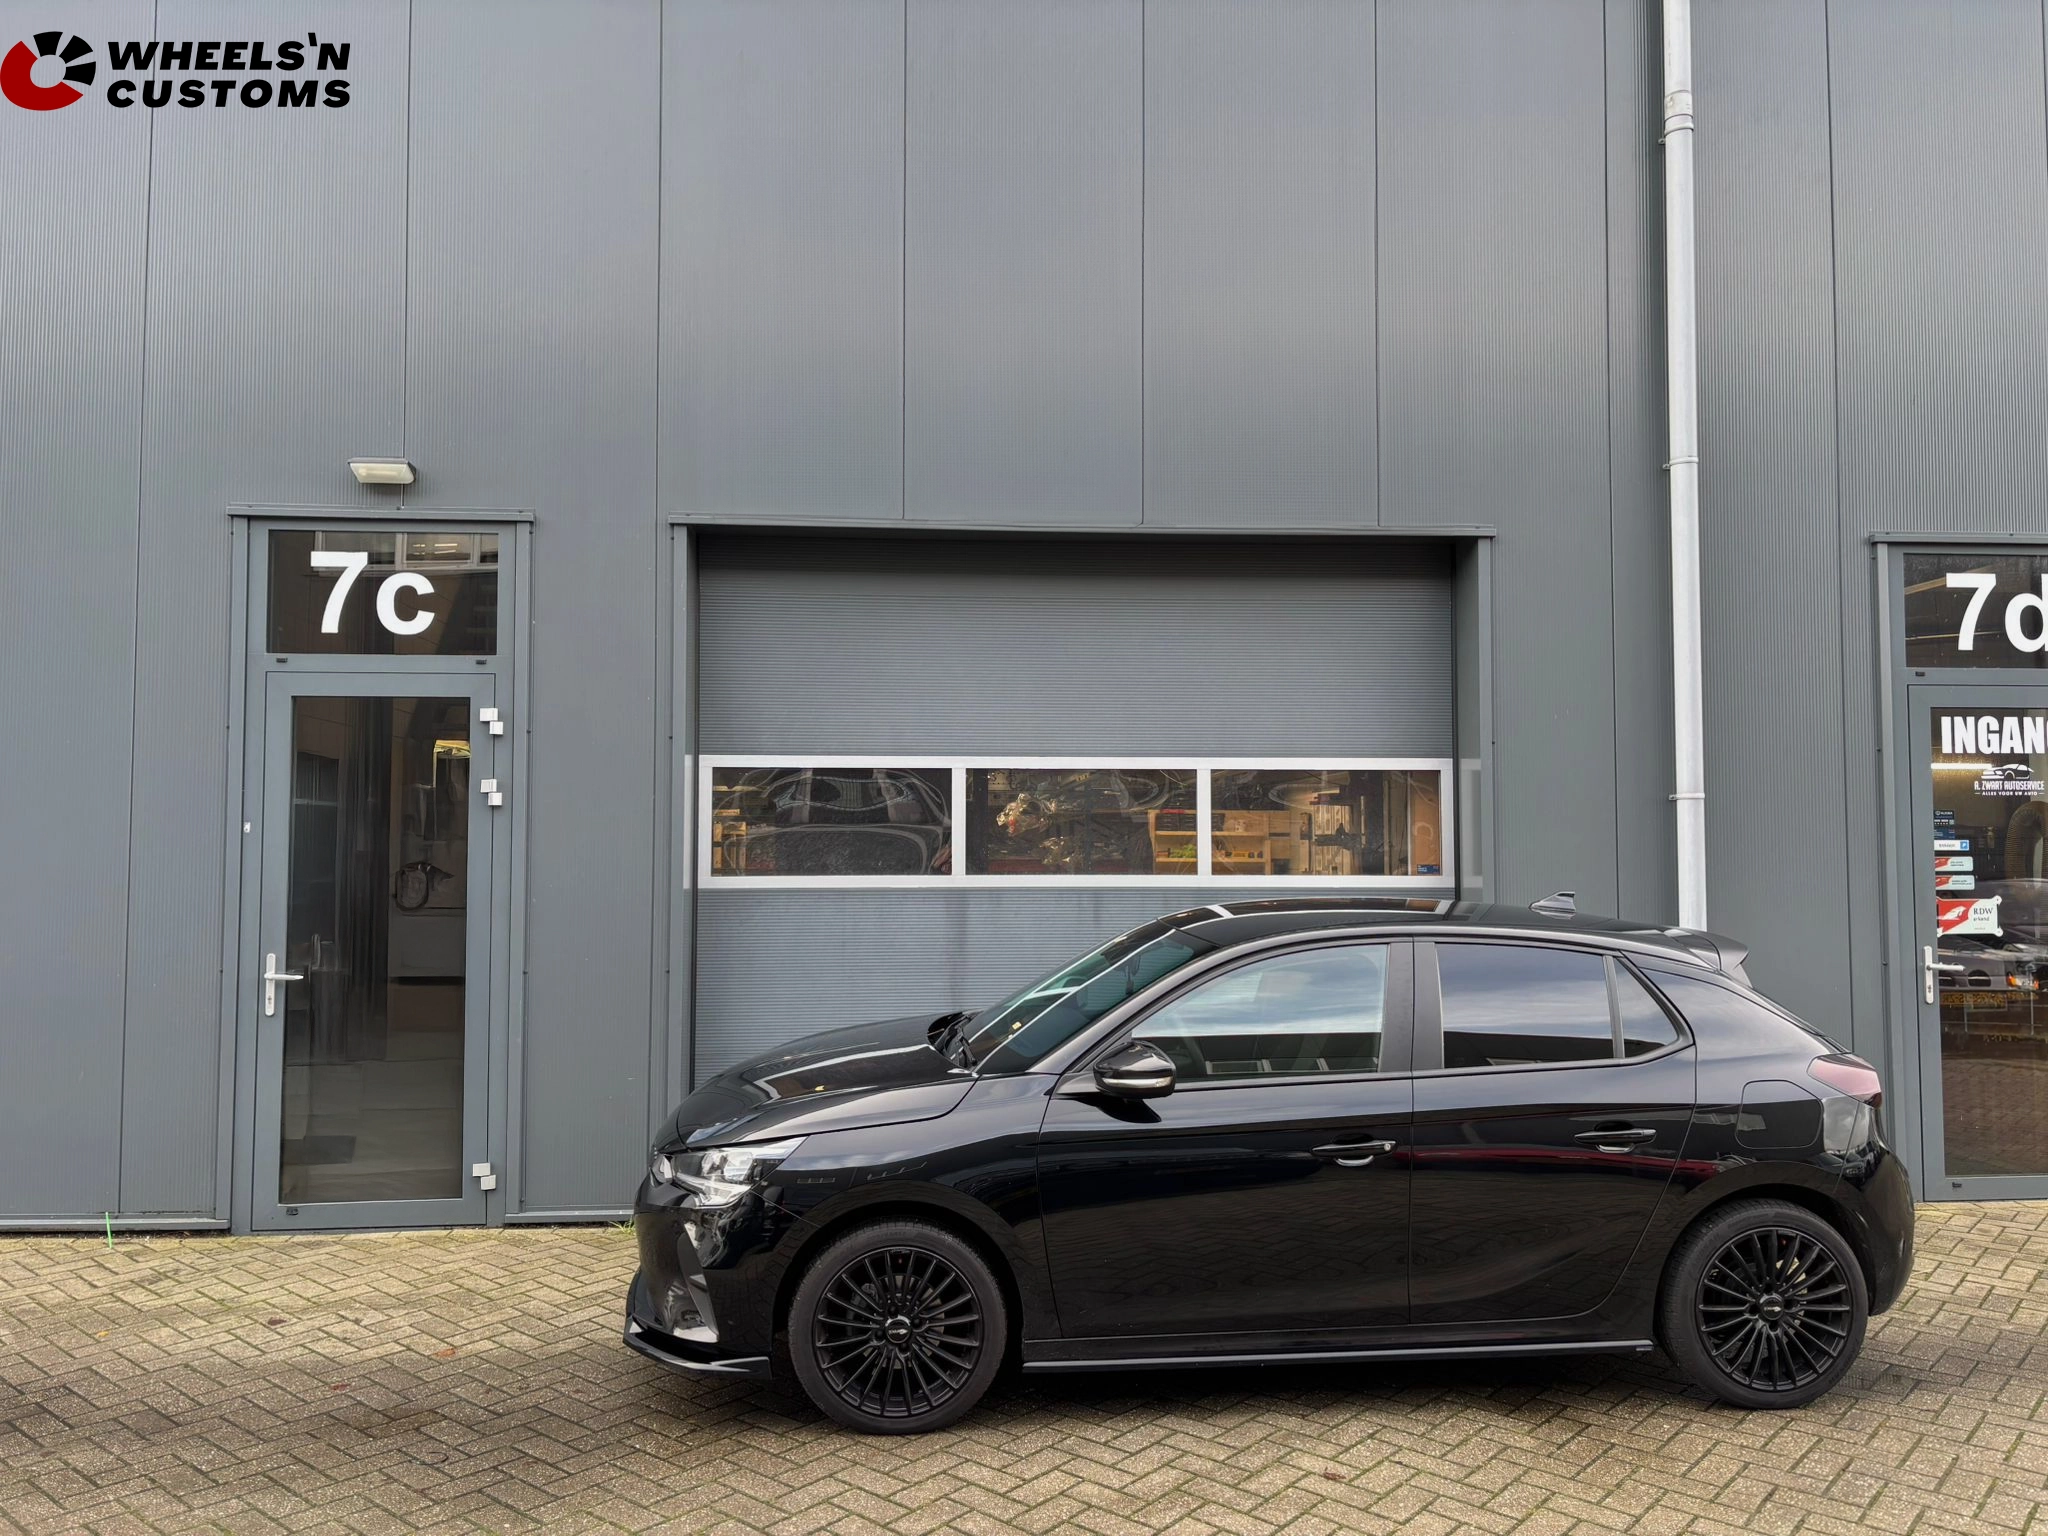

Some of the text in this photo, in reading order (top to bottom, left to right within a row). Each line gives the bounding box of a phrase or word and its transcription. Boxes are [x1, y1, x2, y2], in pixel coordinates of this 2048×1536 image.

[310, 551, 435, 635] 7c
[1946, 572, 2048, 652] 7d
[1941, 715, 2048, 754] INGAN
[2004, 781, 2044, 790] AUTOSERVICE
